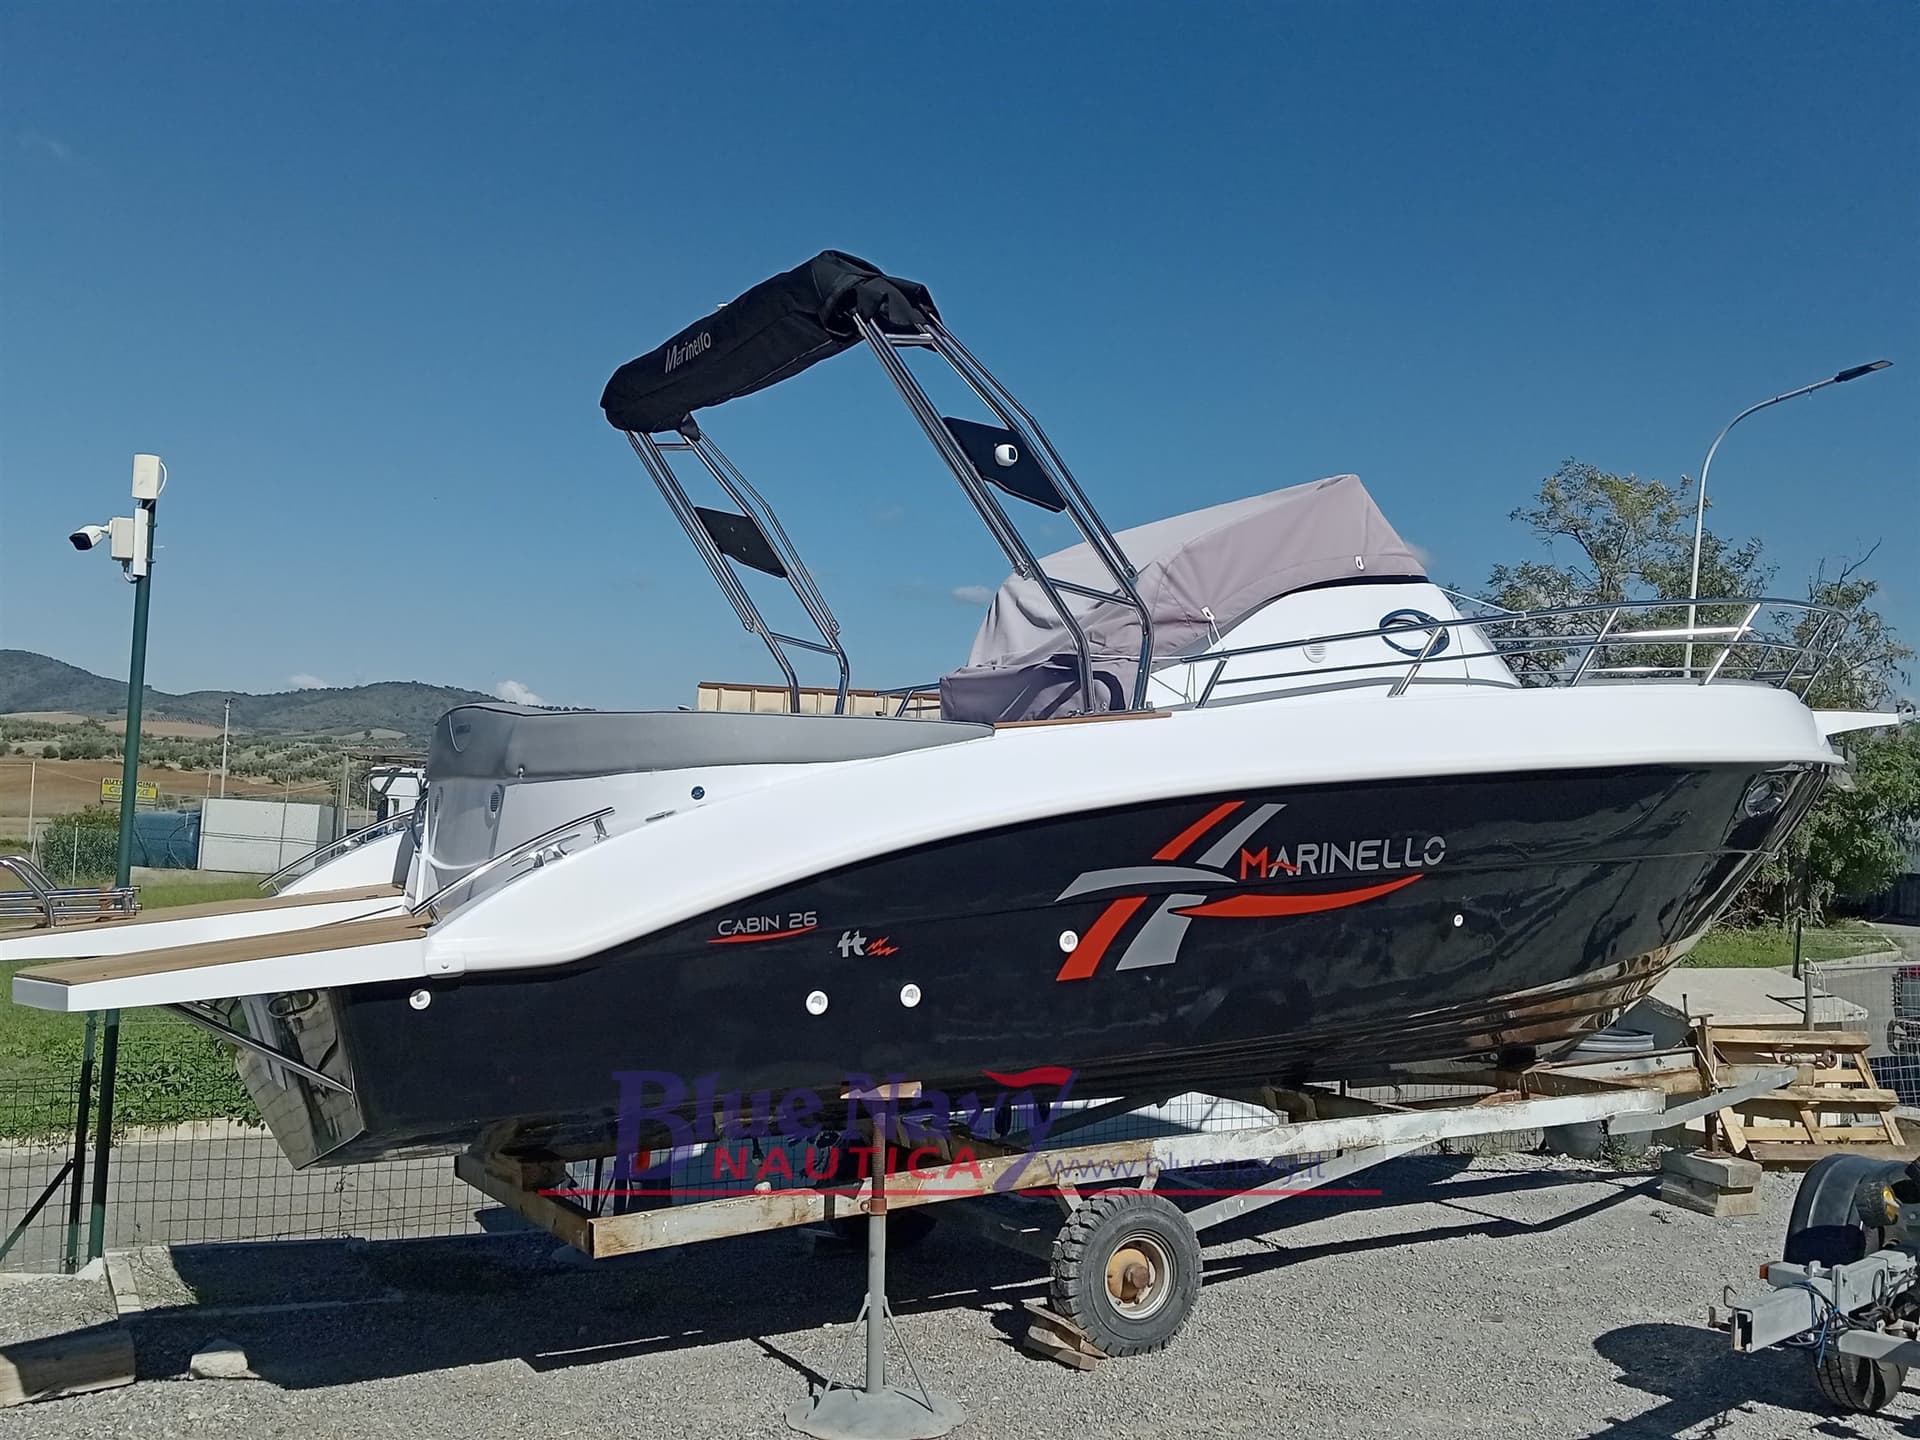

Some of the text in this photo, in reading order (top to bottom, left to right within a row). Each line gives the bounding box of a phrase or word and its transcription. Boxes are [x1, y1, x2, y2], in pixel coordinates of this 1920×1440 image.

[665, 331, 711, 373] Marinello
[1240, 836, 1446, 880] MARINELLO
[718, 911, 818, 936] CABIN 26
